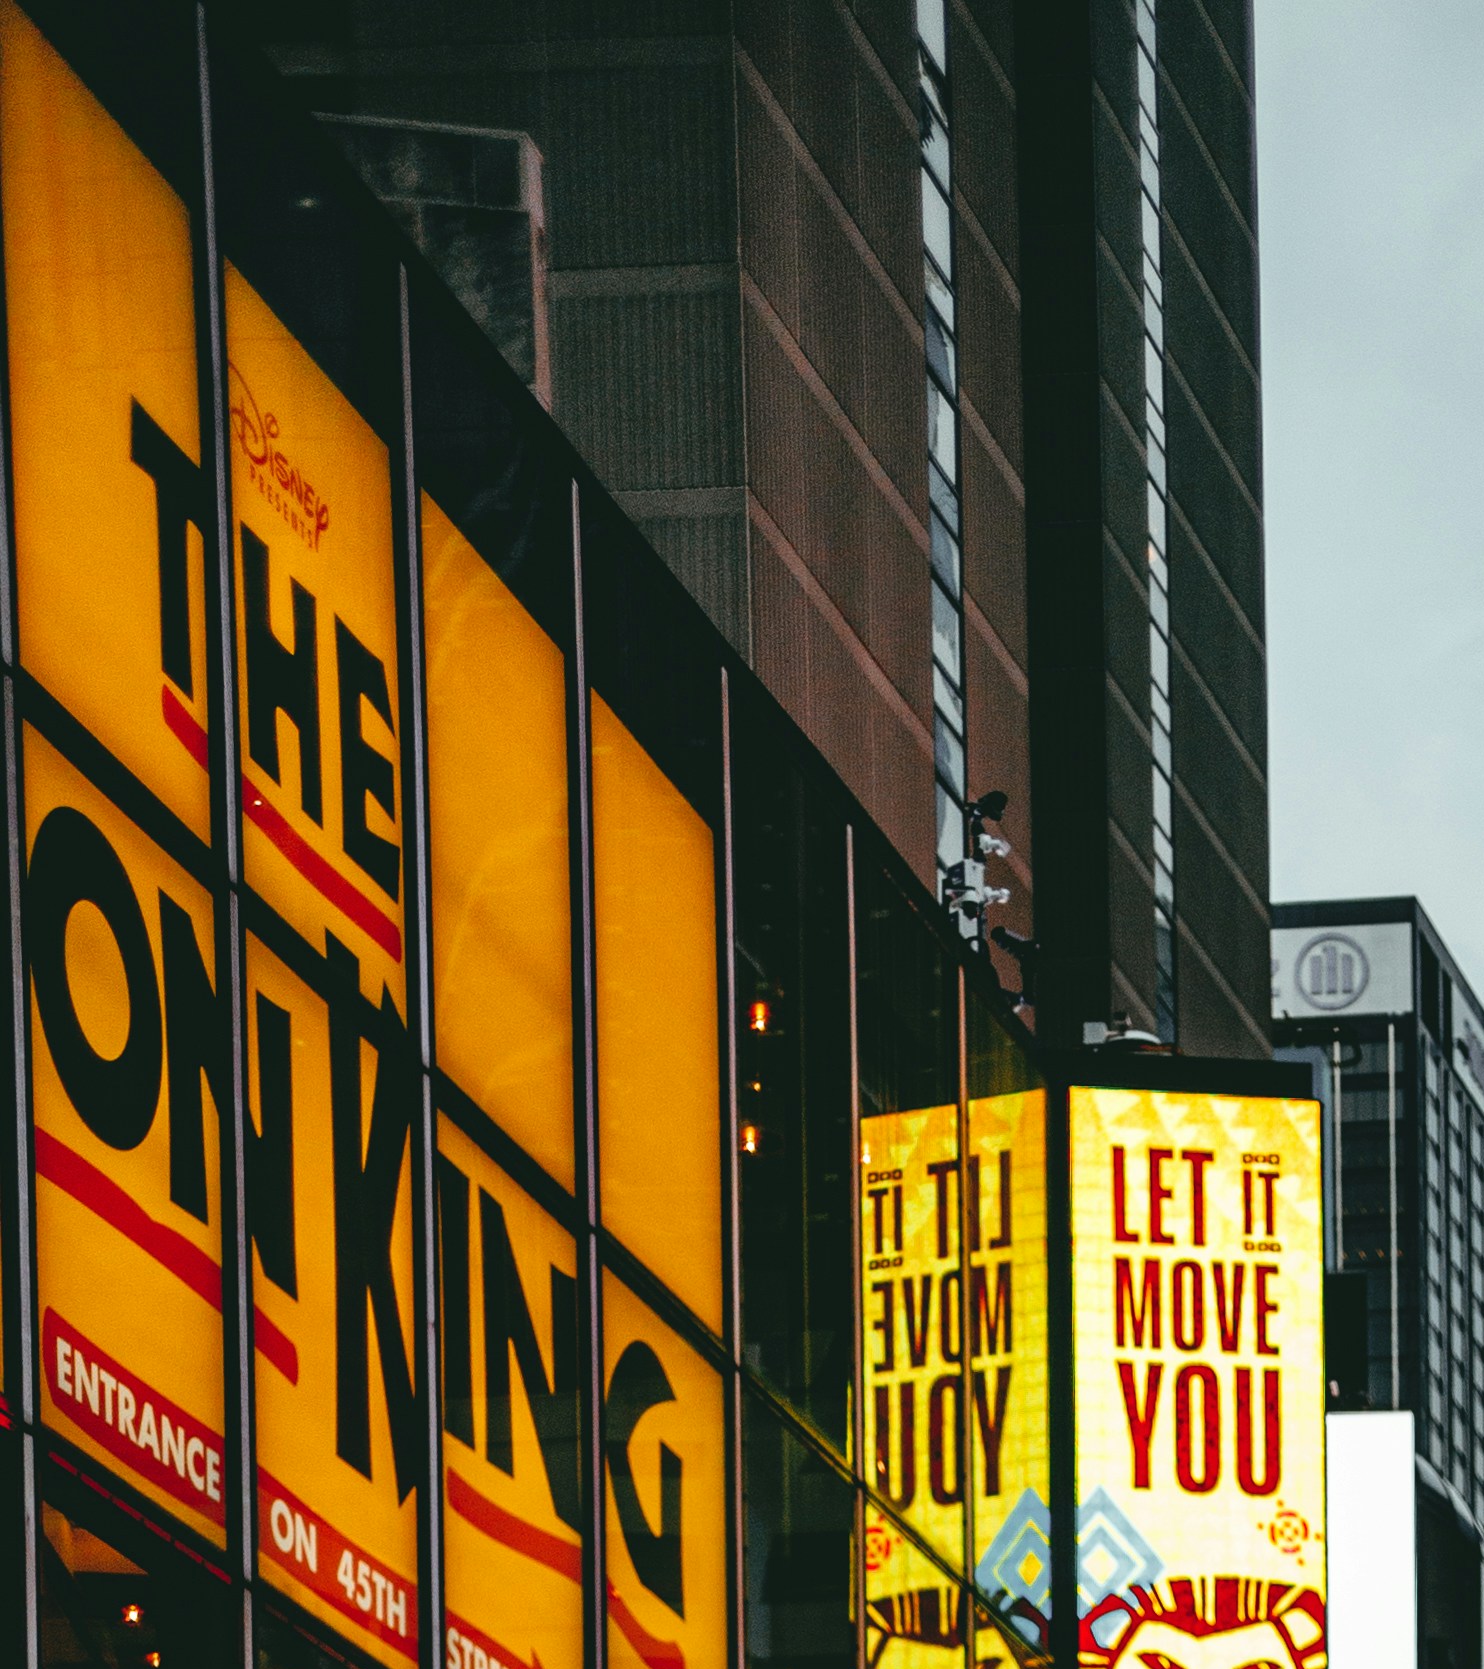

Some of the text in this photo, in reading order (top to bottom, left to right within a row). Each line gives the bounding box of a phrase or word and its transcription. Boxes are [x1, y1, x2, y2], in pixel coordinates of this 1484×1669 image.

[131, 395, 402, 905] THE
[325, 925, 687, 1622] KING
[1111, 1146, 1281, 1247] LET IT
[1114, 1258, 1280, 1356] MOVE
[56, 1336, 223, 1504] ENTRANCE
[270, 1498, 319, 1574] ON
[336, 1551, 407, 1638] 45TH
[1119, 1361, 1283, 1497] YOU
